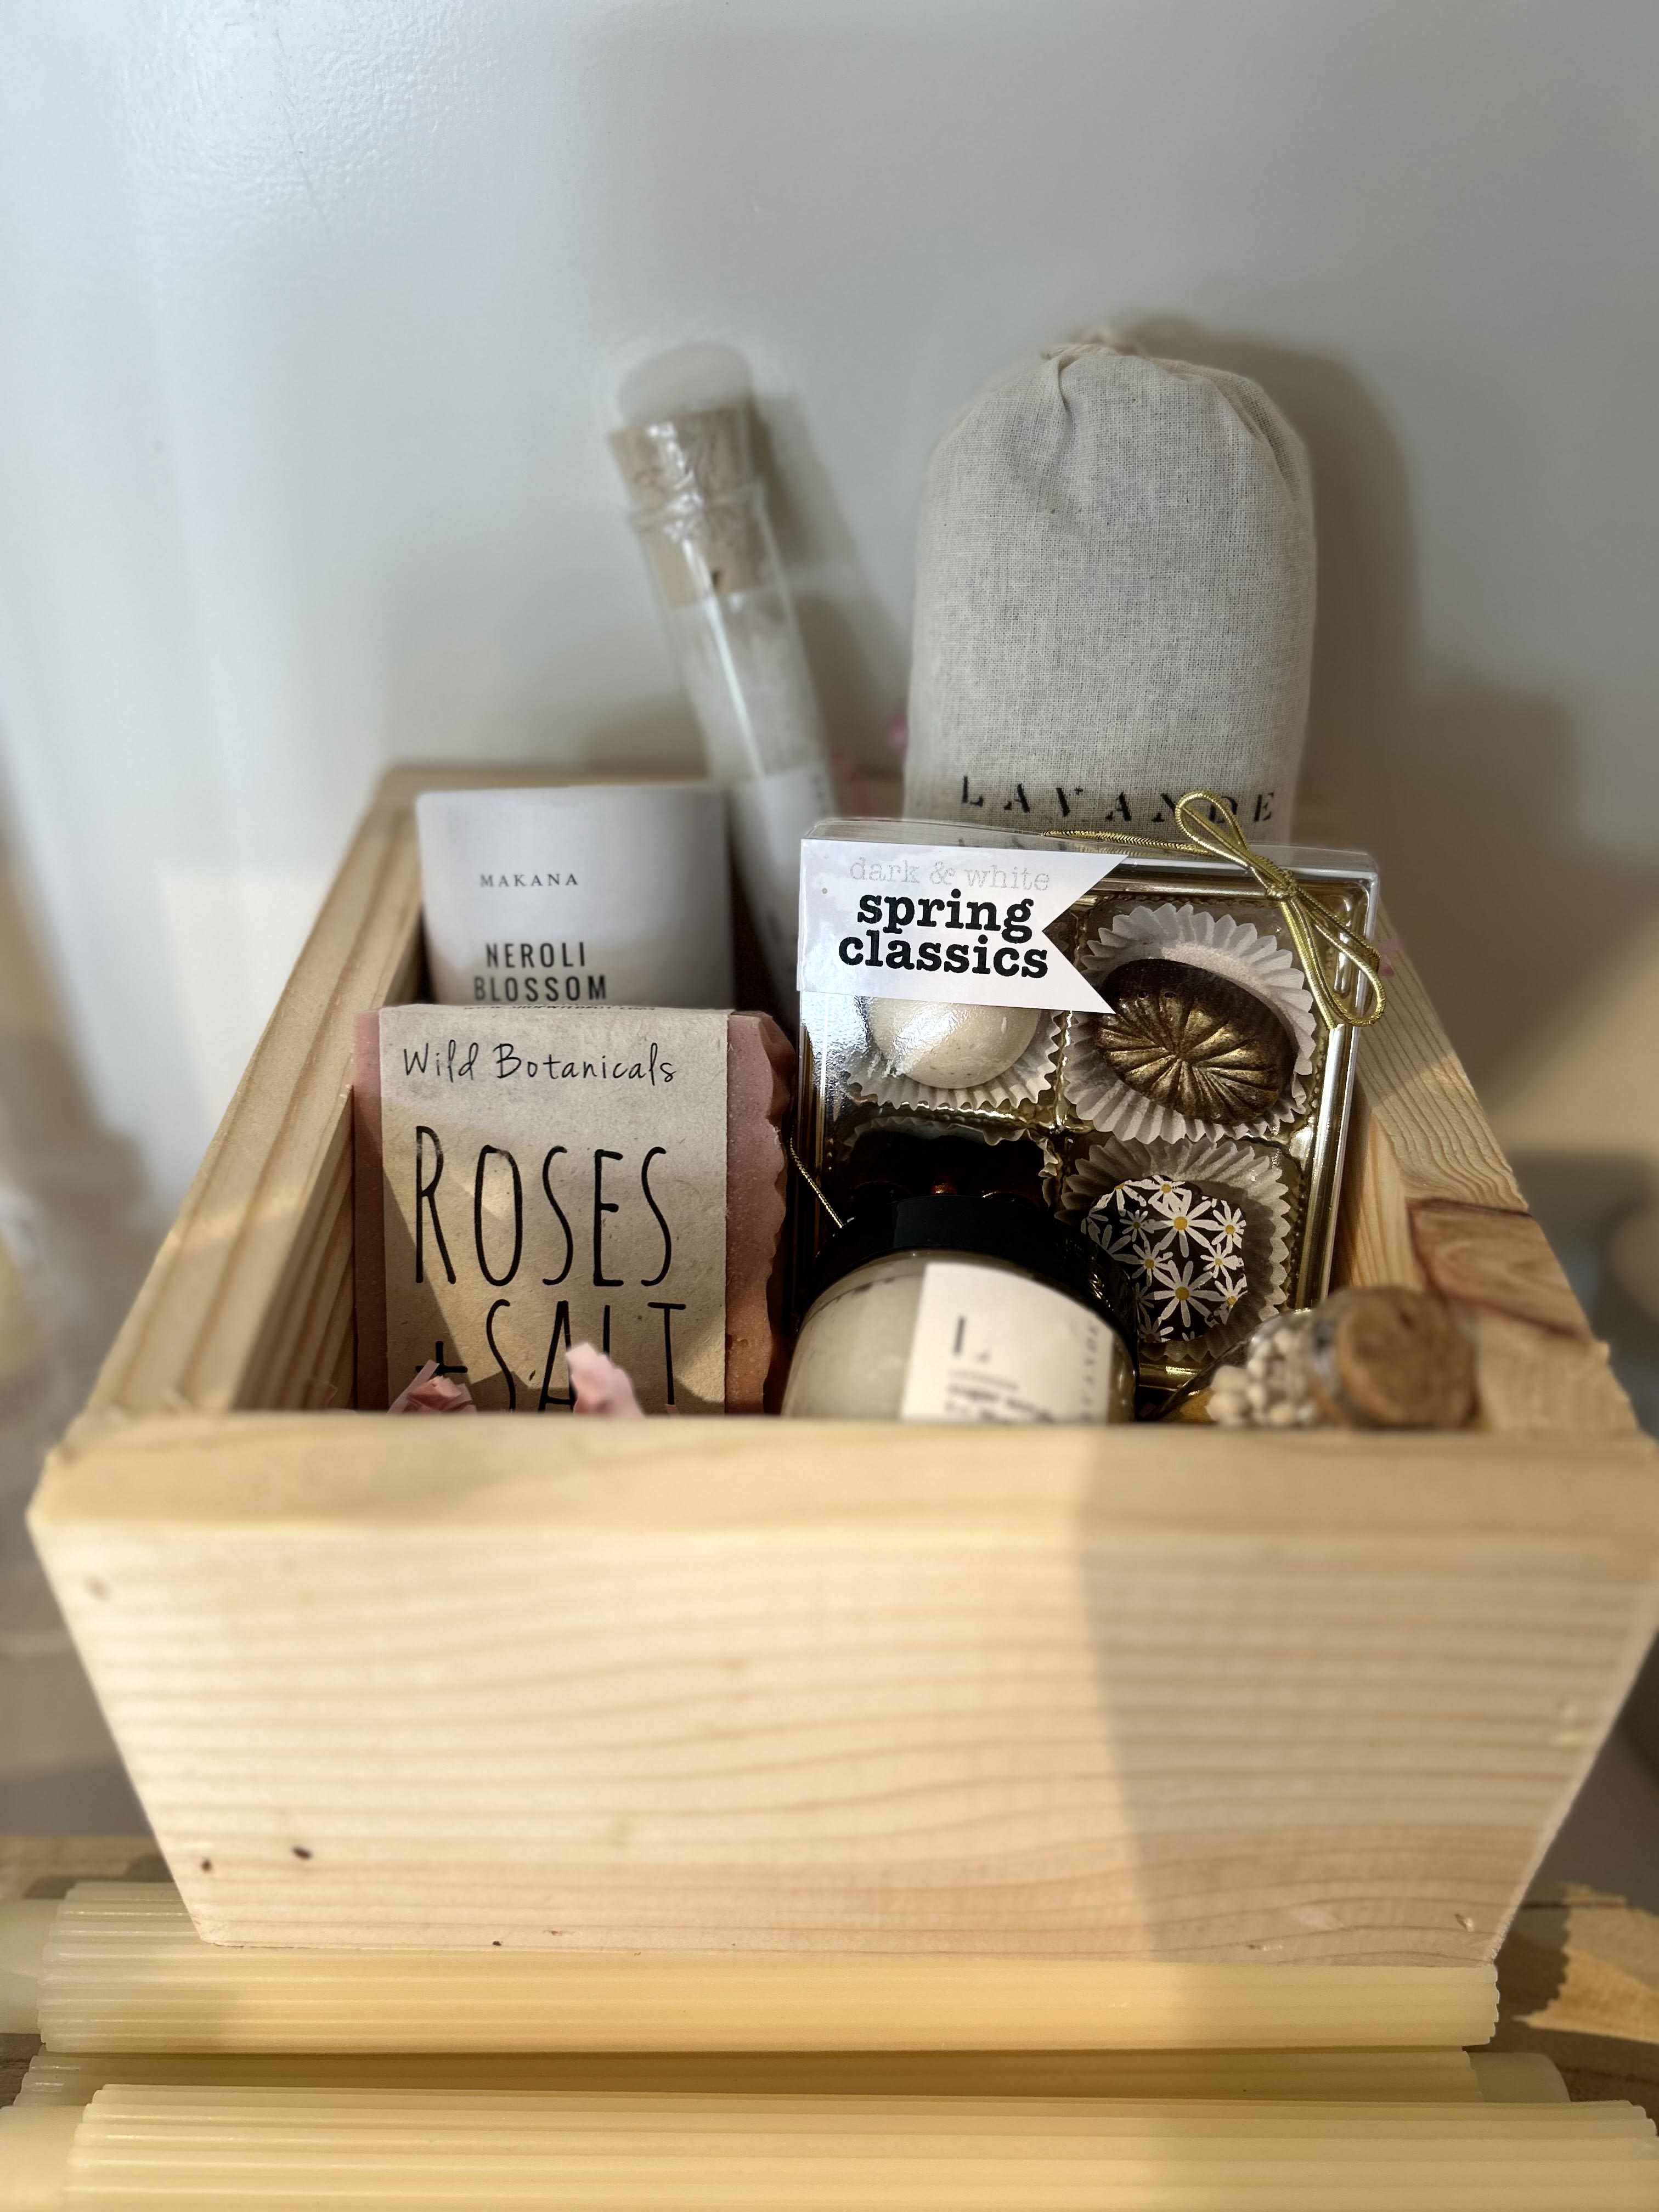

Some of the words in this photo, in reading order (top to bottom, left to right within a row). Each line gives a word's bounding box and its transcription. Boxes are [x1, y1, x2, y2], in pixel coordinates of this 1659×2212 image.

[960, 774, 1275, 823] LAVANDE
[480, 873, 579, 888] MAKANA
[850, 856, 921, 884] dark
[929, 860, 956, 885] &
[963, 864, 1051, 891] white
[857, 888, 1034, 944] spring
[485, 941, 586, 969] NEROLI
[838, 929, 1048, 979] classics
[473, 974, 607, 1002] BLOSSOM
[403, 1039, 479, 1084] Wild
[493, 1042, 678, 1086] Botanicals
[415, 1125, 673, 1287] ROSES
